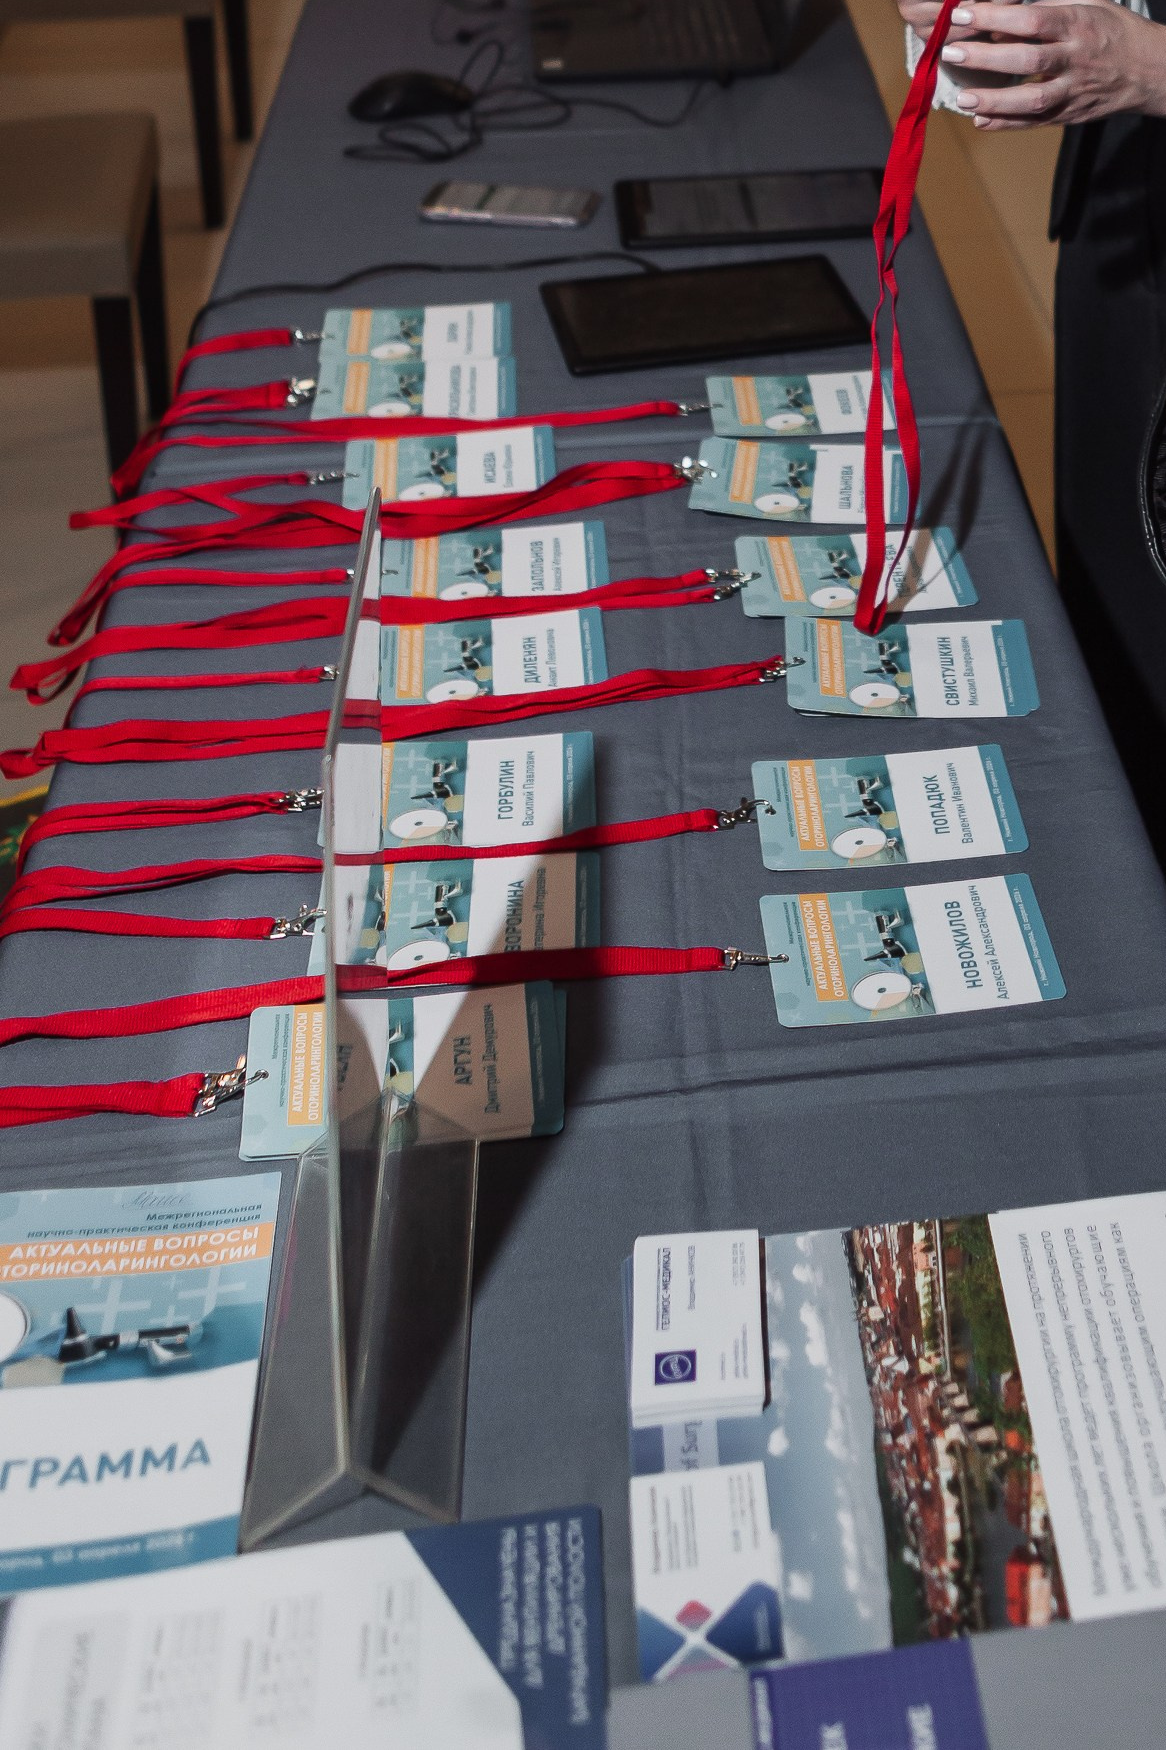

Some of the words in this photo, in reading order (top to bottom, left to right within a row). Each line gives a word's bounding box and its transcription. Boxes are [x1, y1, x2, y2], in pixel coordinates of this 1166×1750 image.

[483, 452, 496, 483] ИСАЕВА
[839, 466, 853, 509] ШАЛЬНОВА
[530, 541, 544, 591] ЗАПОЛЬНОВ
[523, 637, 541, 683] ДИЛЕНЯН
[937, 637, 960, 705] СВИСТУШКИН
[961, 636, 974, 676] Валерьевич
[967, 679, 979, 705] Михаил
[498, 761, 514, 820] ГОРБУЛИН
[523, 751, 535, 788] Павлович
[791, 767, 803, 798] ВОПРОСЫ
[946, 762, 963, 802] Иванович
[522, 792, 534, 826] Василий
[798, 800, 810, 841] АКТУАЛЬНЫЕ
[804, 766, 825, 847] ОТОРИНОЛАРИНГОЛОГИИ
[923, 775, 950, 834] ПОПАДЮК
[957, 804, 973, 843] Валентин
[533, 867, 548, 911] Игоревна
[504, 881, 524, 951] ВОРОНИНА
[533, 915, 546, 950] атерина
[803, 901, 817, 938] ВОПРОСЫ
[968, 885, 996, 956] Александрович
[809, 941, 828, 989] АКТУАЛЬНЫЕ
[817, 900, 844, 996] ОТОРИНОЛАРИНГОЛОГИИ
[944, 901, 983, 988] НОВОЖИЛОВ
[987, 959, 1009, 999] Алексей
[296, 1013, 307, 1053] ВОПРОСЫ
[292, 1056, 305, 1112] АКТУАЛЬНЫЕ
[309, 1012, 323, 1120] ОТОРИНОЛАРИНГОЛОГИИ
[452, 1035, 472, 1085] АРГУН
[484, 1064, 500, 1113] Дмитрий
[27, 1222, 169, 1239] научно-практическая
[172, 1214, 261, 1230] конференция
[146, 1204, 262, 1222] Межрегиональная
[1110, 1222, 1123, 1243] как
[0, 1244, 258, 1280] ТОРИНОЛАРИНГОЛОГИИ
[9, 1239, 146, 1260] АКТУАЛЬНЫЕ
[153, 1226, 260, 1250] ВОПРОСЫ
[1064, 1228, 1091, 1305] отохирургов
[1086, 1225, 1116, 1306] обучающие
[662, 1248, 671, 1330] ГЕЛИОС-МЕДИКАЛ
[1018, 1233, 1044, 1309] протяжении
[1040, 1231, 1069, 1320] непрерывного
[1117, 1247, 1144, 1322] операциям
[1035, 1312, 1045, 1327] на
[1040, 1329, 1065, 1414] отохирургии
[1062, 1324, 1089, 1399] программу
[1084, 1308, 1117, 1406] квалификации
[1108, 1311, 1150, 1435] организовывает
[0, 1436, 211, 1492] ГРАММА
[1143, 1442, 1165, 1495] Школа
[522, 1524, 538, 1537] И
[568, 1518, 585, 1599] ПОЛОСТИ
[499, 1528, 519, 1670] ПРЕДНАЗНАЧЕНЫ
[522, 1539, 541, 1646] ВЕНТИЛЯЦИИ
[545, 1522, 566, 1654] ДРЕНИРОВАНИЯ
[524, 1650, 543, 1687] ДЛЯ
[568, 1603, 589, 1725] БАРАБАННОЙ
